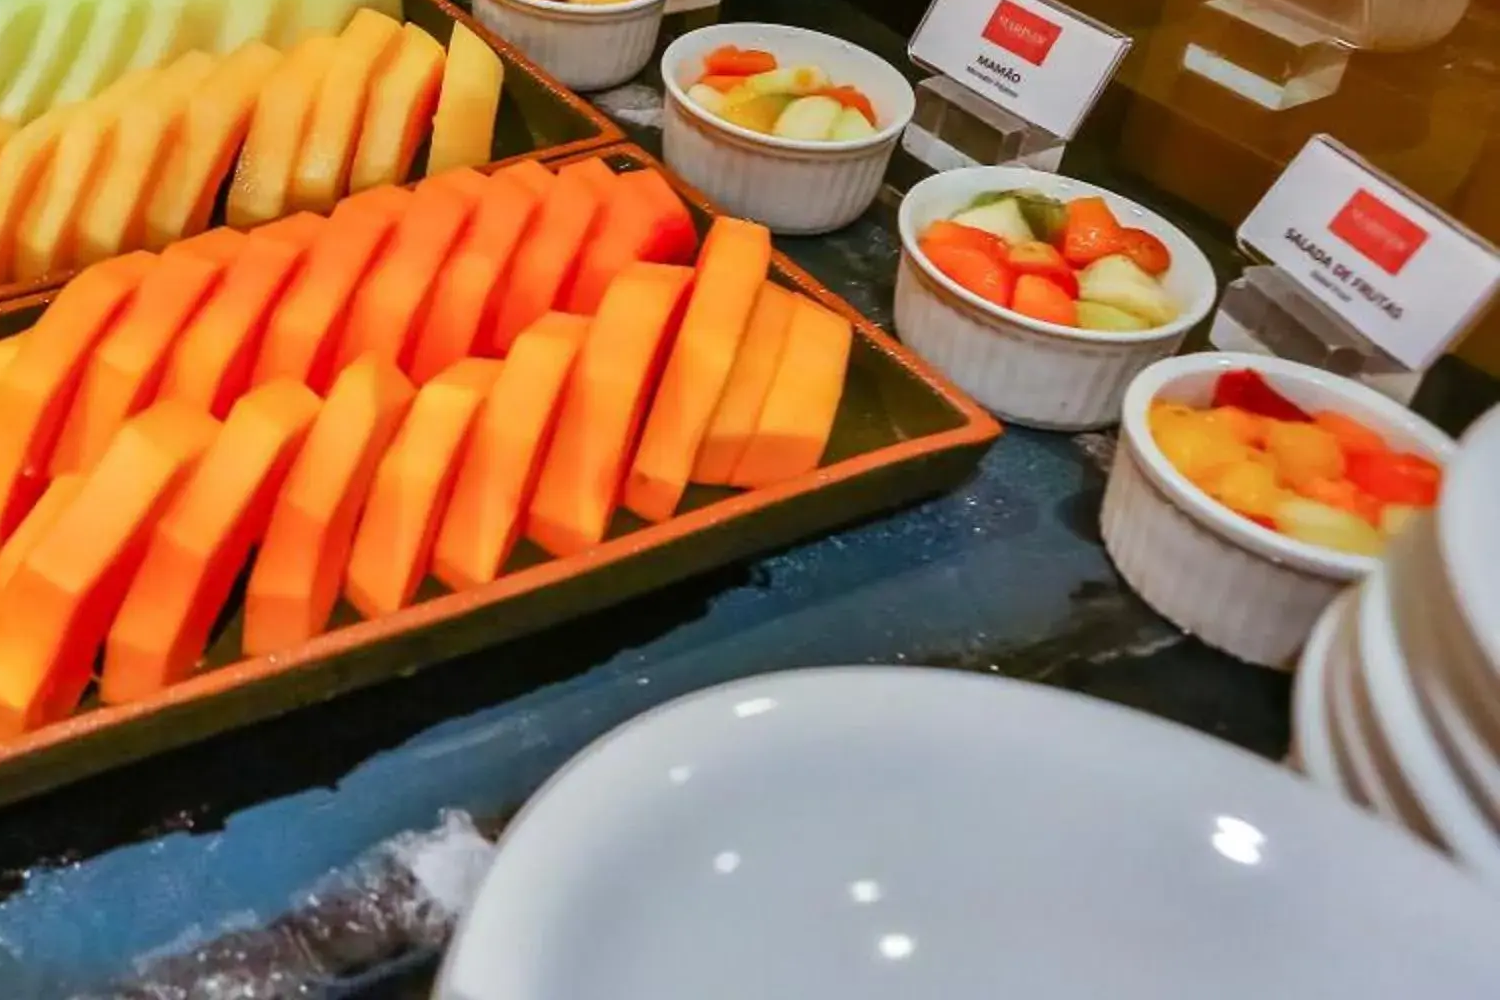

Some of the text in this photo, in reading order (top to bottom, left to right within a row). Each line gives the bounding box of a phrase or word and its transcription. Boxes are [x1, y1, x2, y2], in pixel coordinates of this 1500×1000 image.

[975, 54, 1022, 84] MAMÃO
[1284, 226, 1333, 270] SALADA
[1331, 262, 1354, 284] DE
[1350, 276, 1405, 321] FRUTAS
